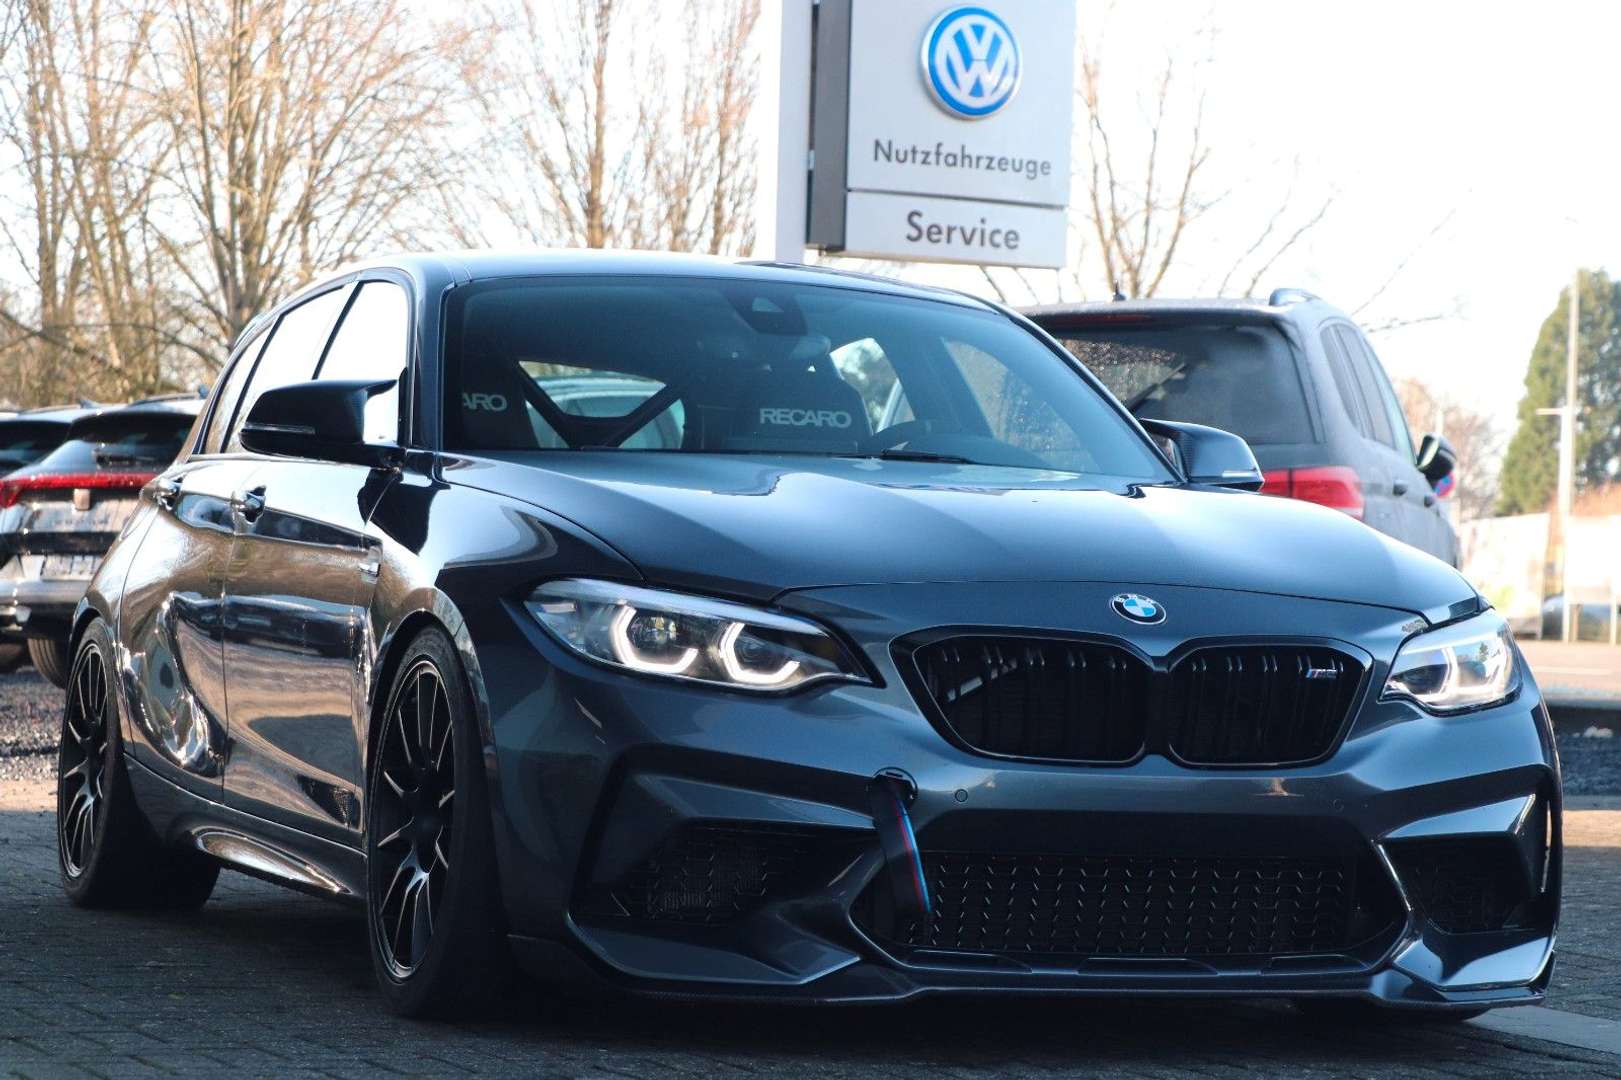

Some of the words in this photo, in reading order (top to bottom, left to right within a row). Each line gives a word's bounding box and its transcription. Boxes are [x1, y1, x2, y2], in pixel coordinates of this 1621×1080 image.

[873, 139, 1051, 180] Nutzfahrzeuge
[905, 210, 1020, 249] Service
[759, 408, 852, 429] RECARO
